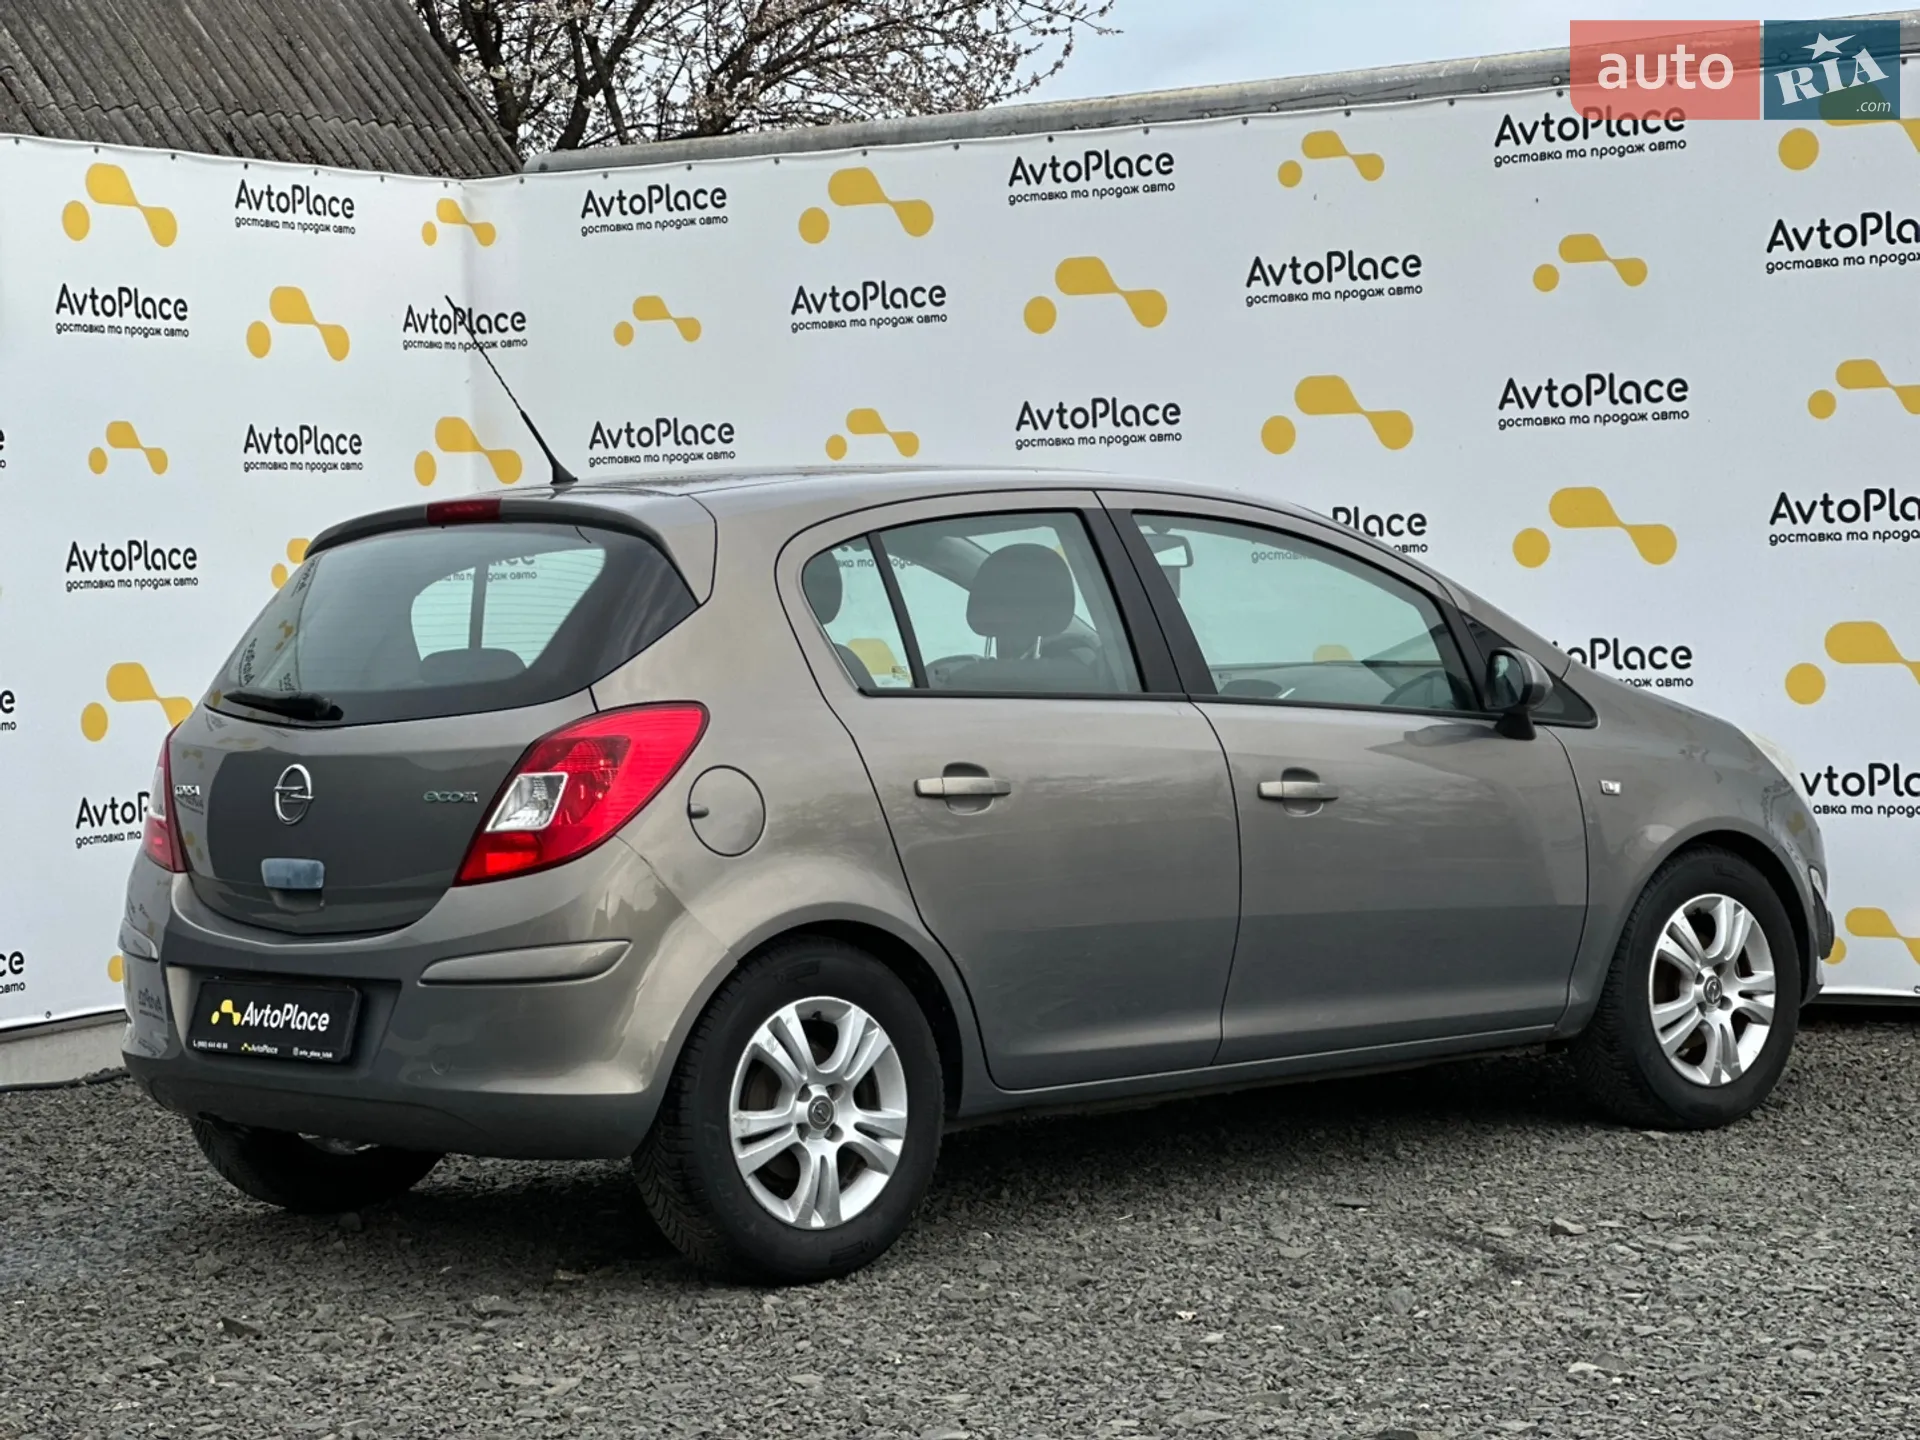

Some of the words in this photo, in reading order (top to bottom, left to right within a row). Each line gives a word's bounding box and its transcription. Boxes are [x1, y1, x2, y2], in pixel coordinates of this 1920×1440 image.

[1493, 104, 1687, 149] AvtoPlace
[1007, 148, 1175, 188] AvtoPlace
[1493, 148, 1563, 169] доставка
[1565, 147, 1587, 160] та
[1590, 142, 1646, 160] продаж
[1647, 139, 1687, 153] авто
[234, 178, 355, 220] AvtoPlace
[580, 182, 728, 220] AvtoPlace
[1007, 190, 1068, 206] доставка
[1070, 188, 1090, 199] та
[1091, 185, 1140, 200] продаж
[1141, 182, 1176, 194] авто
[234, 216, 281, 230] доставка
[281, 220, 296, 231] та
[296, 221, 332, 235] продаж
[332, 224, 356, 235] авто
[580, 222, 634, 238] доставка
[635, 220, 653, 231] та
[654, 217, 697, 232] продаж
[698, 215, 729, 226] авто
[1765, 210, 1920, 254] AvtoPla
[1245, 249, 1423, 289] AvtoPlace
[1765, 257, 1840, 275] доставка
[1842, 255, 1866, 267] та
[55, 282, 189, 322] AvtoPlace
[790, 279, 947, 316] AvtoPlace
[1245, 291, 1309, 308] доставка
[1311, 290, 1332, 301] та
[1334, 287, 1385, 303] продаж
[1387, 284, 1424, 297] авто
[55, 322, 106, 335] доставка
[106, 324, 123, 335] та
[123, 325, 163, 339] продаж
[163, 327, 190, 339] авто
[402, 303, 527, 336] AvtoPlace
[790, 319, 848, 335] доставка
[849, 318, 867, 328] та
[869, 315, 915, 330] продаж
[915, 313, 948, 324] авто
[402, 339, 443, 351] доставка
[443, 341, 457, 351] та
[499, 338, 529, 349] авто
[1497, 371, 1690, 411] AvtoPlace
[1015, 396, 1182, 432] AvtoPlace
[1497, 415, 1567, 431] доставка
[1569, 414, 1591, 425] та
[1593, 411, 1649, 427] продаж
[1650, 409, 1690, 422] авто
[243, 423, 363, 456] AvtoPlace
[588, 416, 735, 451] AvtoPlace
[1014, 436, 1076, 451] доставка
[1077, 435, 1097, 446] та
[1098, 433, 1147, 448] продаж
[1148, 431, 1183, 443] авто
[243, 461, 289, 474] доставка
[289, 461, 304, 471] та
[304, 461, 339, 474] продаж
[339, 461, 364, 471] авто
[588, 454, 642, 469] доставка
[643, 453, 661, 463] та
[661, 451, 705, 465] продаж
[705, 450, 737, 461] авто
[1331, 505, 1429, 538] Place
[1768, 487, 1920, 527] AvtoPla
[1768, 531, 1843, 547] доставка
[1845, 530, 1869, 542] та
[1872, 528, 1920, 544] прода
[65, 539, 198, 574] AvtoPlace
[65, 579, 116, 594] доставка
[117, 578, 133, 589] та
[133, 577, 172, 591] продаж
[173, 576, 199, 587] авто
[508, 570, 538, 581] авто
[1654, 677, 1694, 688] авто
[75, 790, 151, 830] AvtoP
[1812, 804, 1848, 815] авка
[1850, 804, 1874, 815] та
[74, 832, 126, 850] доставка
[126, 830, 143, 842] та
[241, 1001, 329, 1032] AvtoPlace
